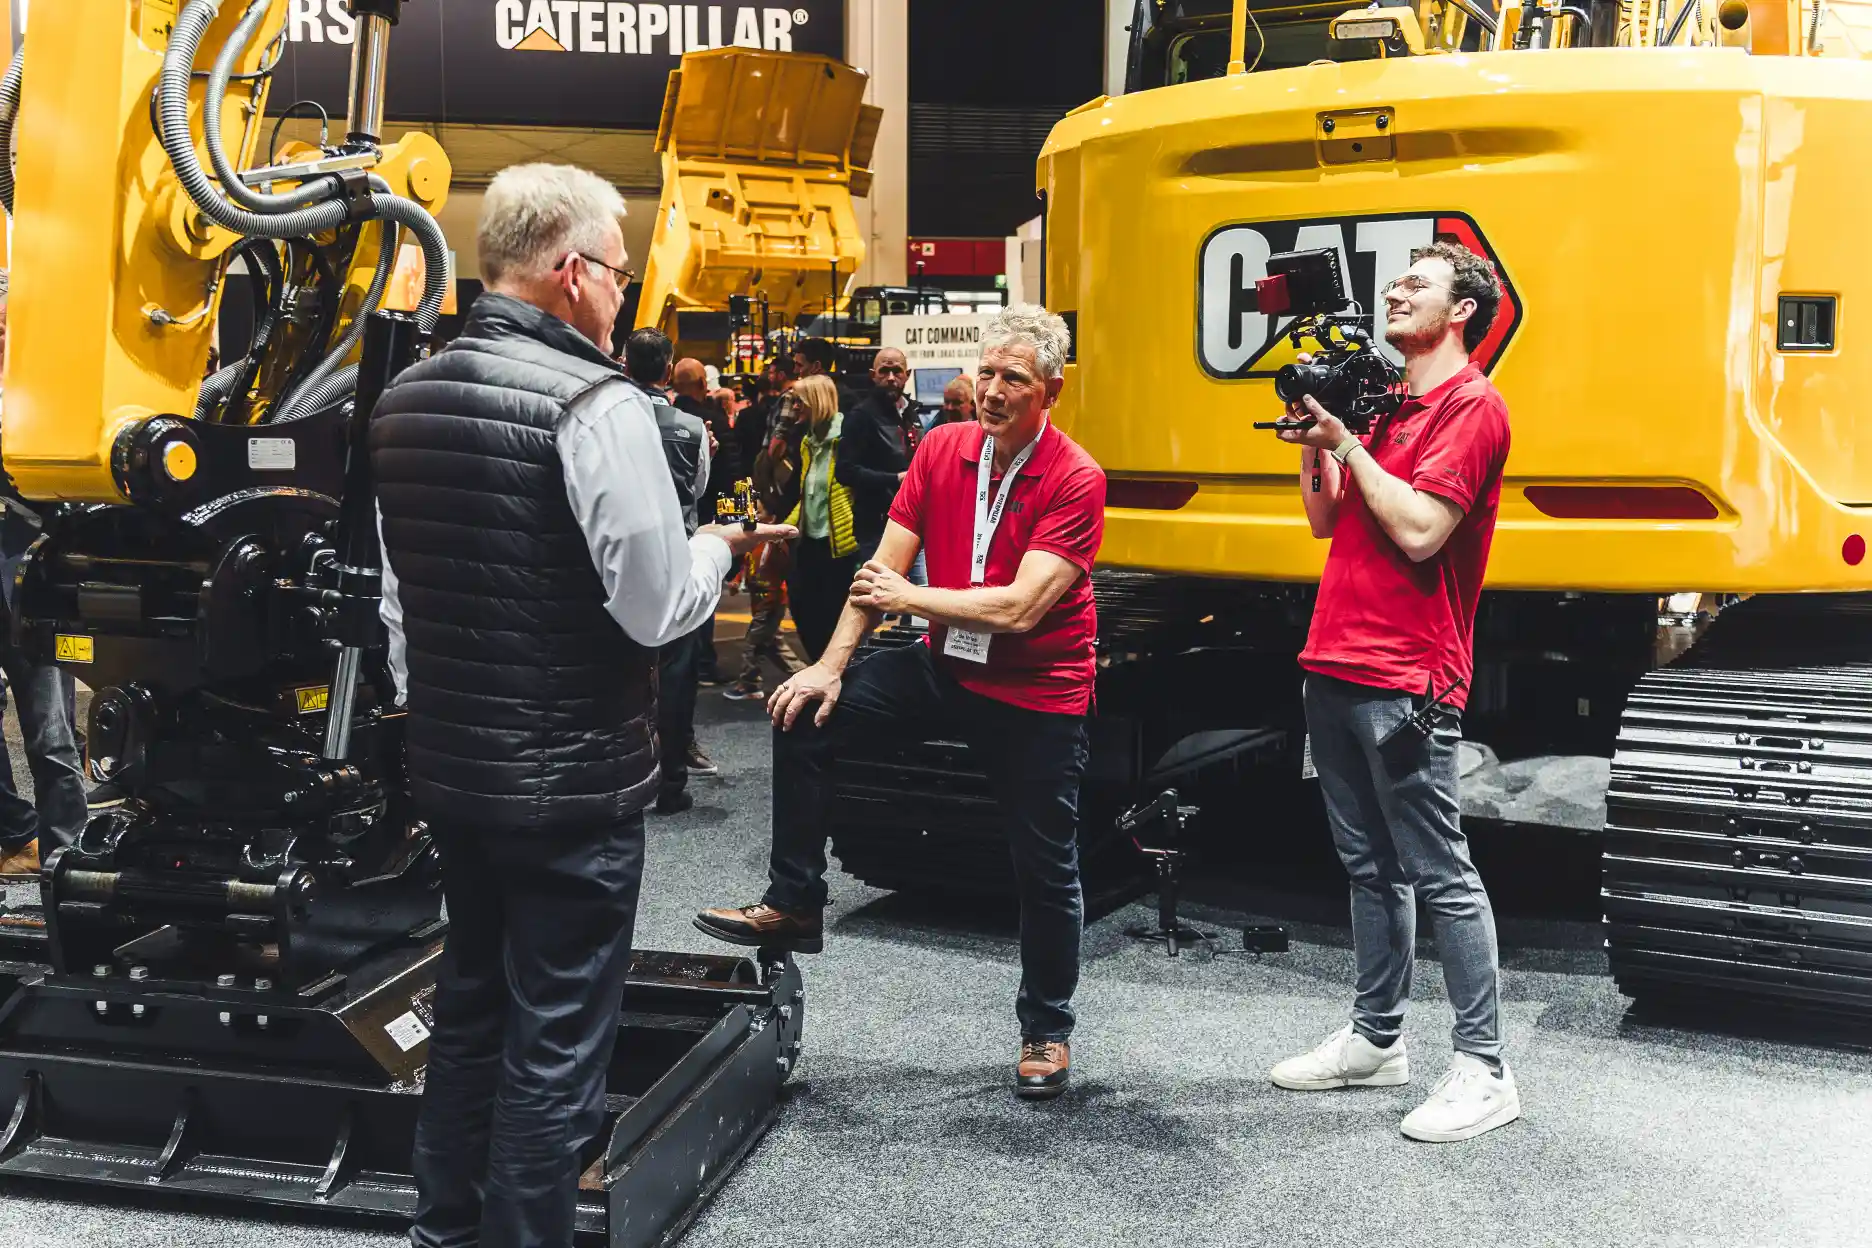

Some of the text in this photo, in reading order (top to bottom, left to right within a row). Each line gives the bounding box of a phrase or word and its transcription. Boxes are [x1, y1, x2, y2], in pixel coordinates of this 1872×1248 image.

[284, 0, 355, 44] RS
[906, 326, 980, 345] CAT COMMAND
